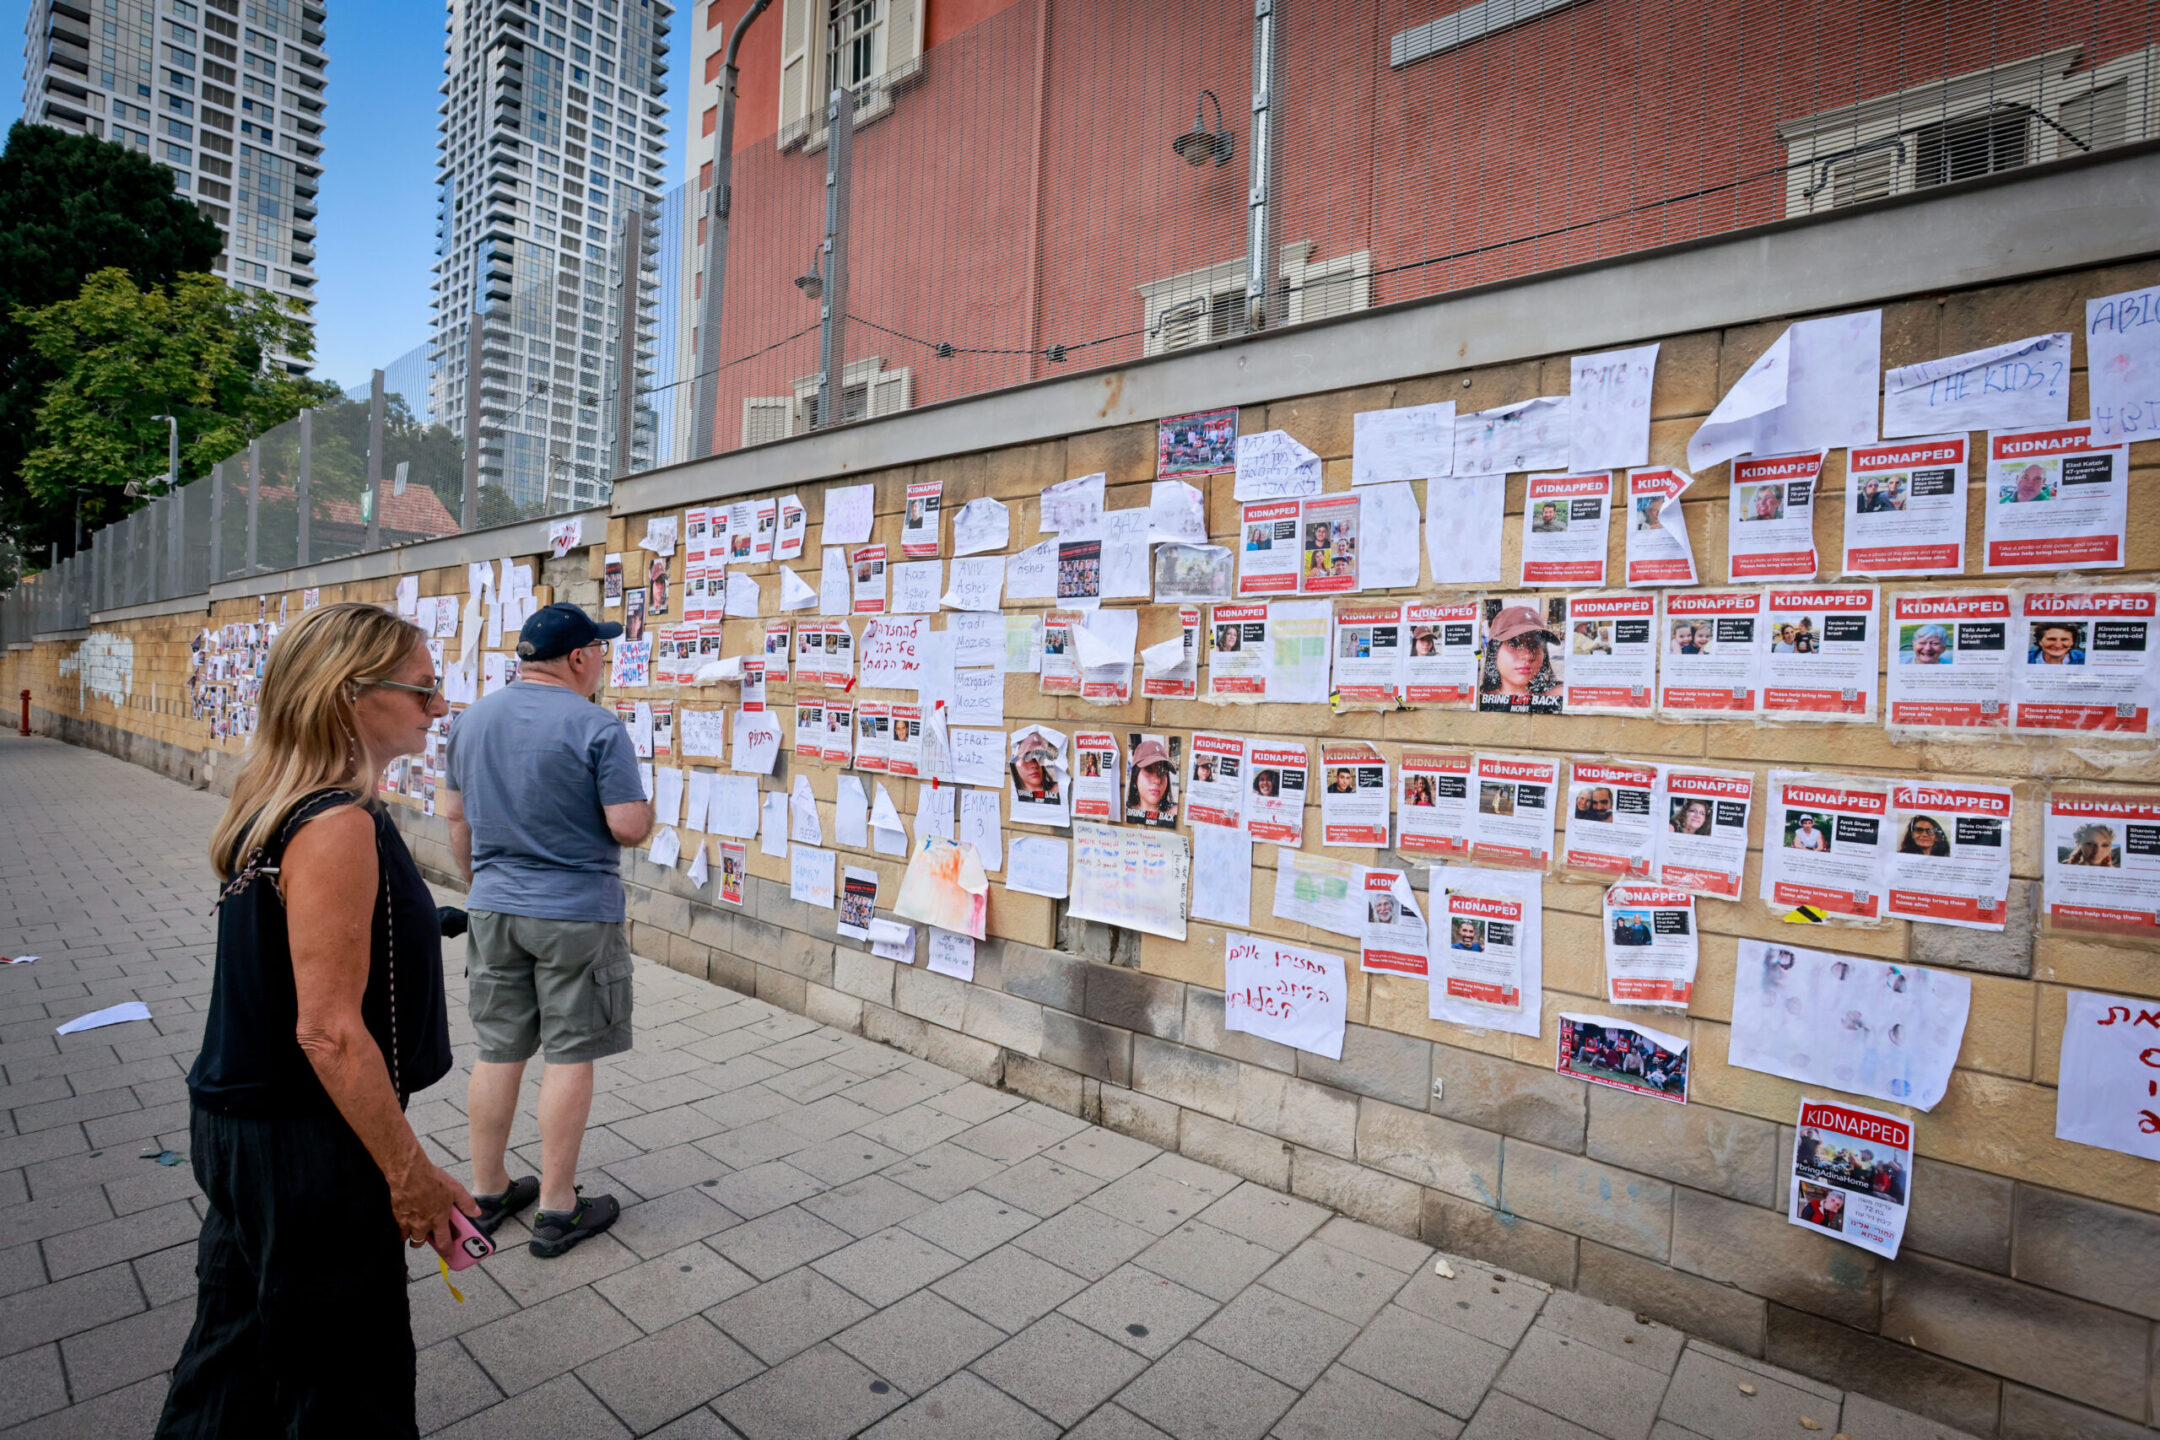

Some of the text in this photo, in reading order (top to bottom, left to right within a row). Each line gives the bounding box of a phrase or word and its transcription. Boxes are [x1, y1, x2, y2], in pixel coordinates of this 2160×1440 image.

[1984, 361, 2063, 396] KIDS?
[2002, 435, 2091, 454] KIDNAPP
[1859, 448, 1956, 467] KIDNAPPED
[1741, 461, 1820, 478] KIDNAPPED
[1535, 482, 1604, 493] KIDNAPPED
[1248, 507, 1297, 518] KIDNAPPED
[1574, 601, 1650, 613] KIDNAPPED
[1671, 598, 1755, 610] KIDNAPPED
[1774, 595, 1868, 606] KIDNAPPED
[2030, 598, 2149, 611] KIDNAPPED
[1216, 608, 1265, 618] KIDNAPPED
[1410, 607, 1474, 618] KIDNAPPED
[1901, 601, 2005, 614] KIDNAPPED
[1481, 694, 1510, 705] BRING
[1531, 695, 1560, 706] BACK
[1079, 738, 1113, 747] KIDNAPP
[1196, 739, 1241, 753] KIDNAPPED
[1254, 753, 1306, 764] KIDNAPPED
[1405, 758, 1467, 769] KIDNAPPED
[1482, 763, 1550, 778] KIDNAPPED
[1671, 779, 1749, 794] KIDNAPPED
[962, 792, 996, 814] EMMA
[1787, 790, 1881, 809] KIDNAPPED
[1898, 791, 2004, 810] KIDNAPPED
[2058, 798, 2160, 814] KIDNAPPE
[1159, 810, 1175, 822] BACK
[1452, 900, 1518, 916] KIDNAPPED
[1806, 1110, 1906, 1145] KIDNAPPED
[1796, 1162, 1870, 1189] #bringAdinaHome
